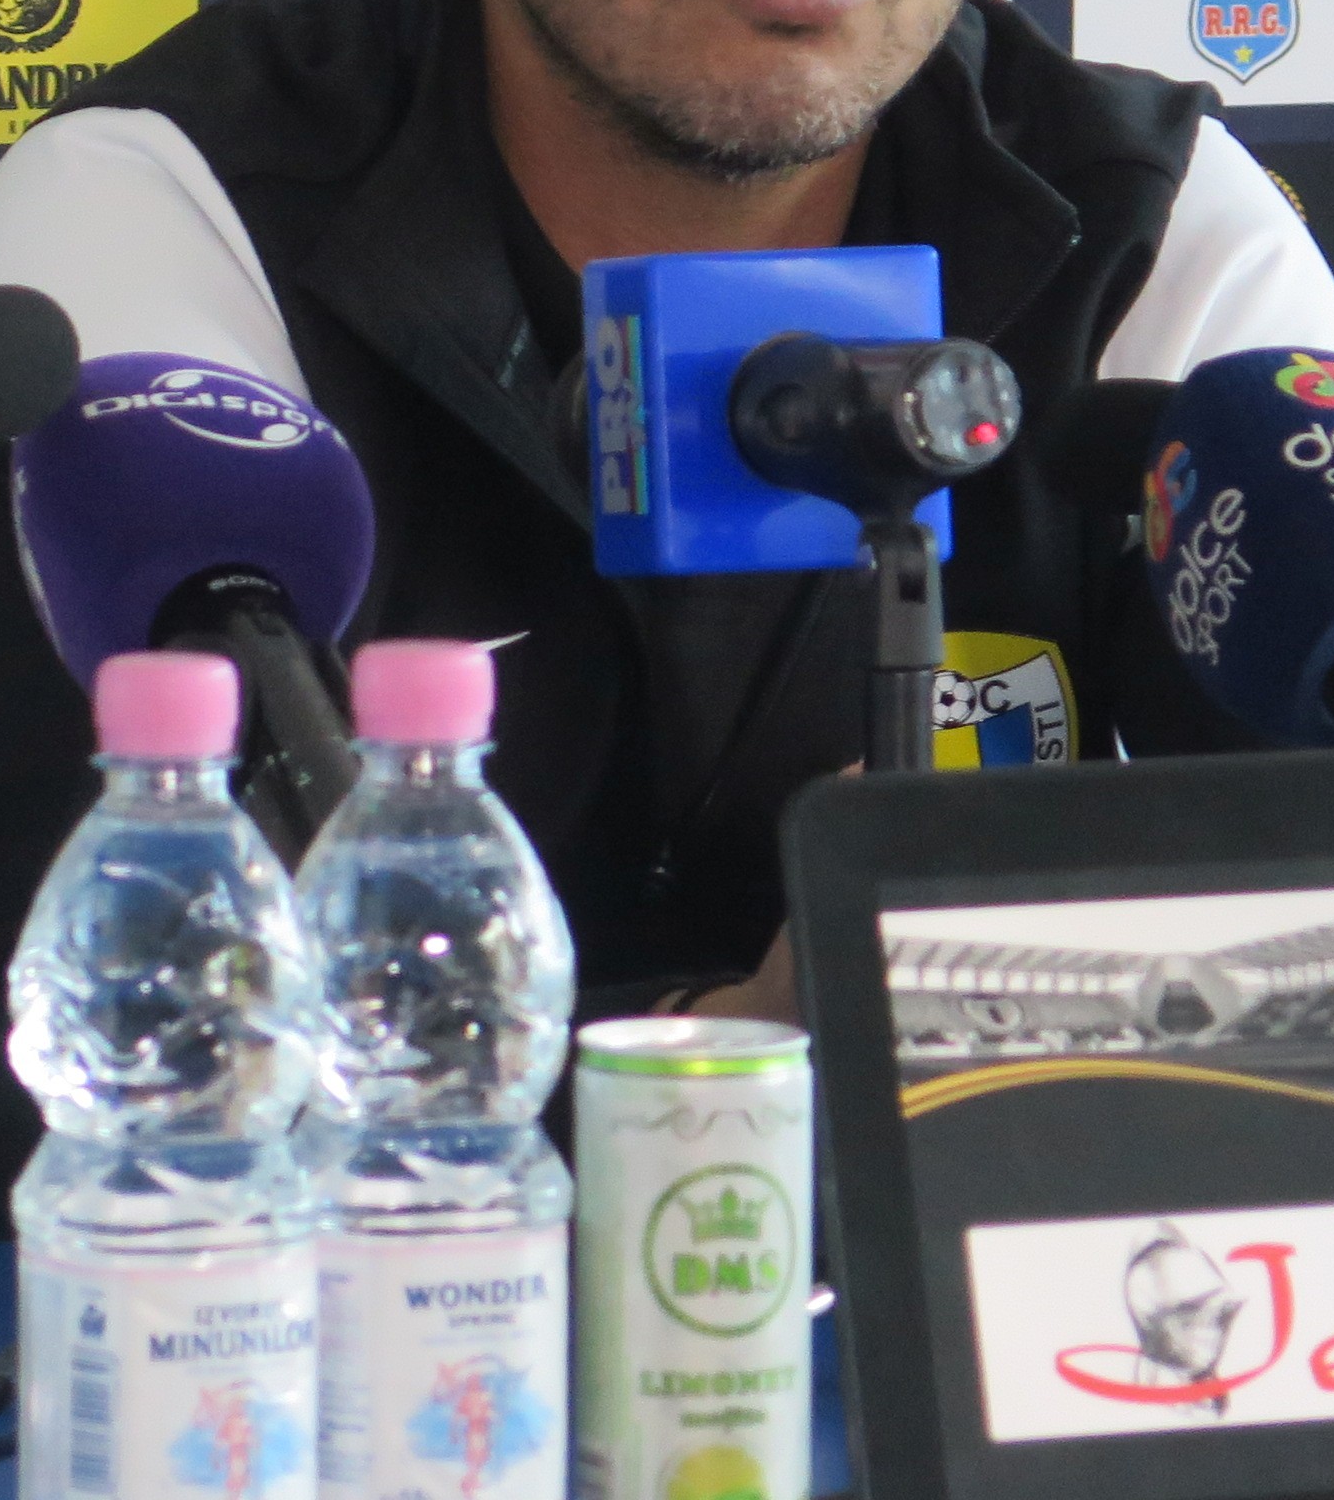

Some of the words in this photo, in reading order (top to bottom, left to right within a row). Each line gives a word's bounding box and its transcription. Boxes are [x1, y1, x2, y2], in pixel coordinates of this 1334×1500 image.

[81, 390, 216, 421] DIGI
[592, 315, 630, 516] PRO
[403, 1275, 548, 1312] WONDER
[672, 1250, 781, 1298] DMS
